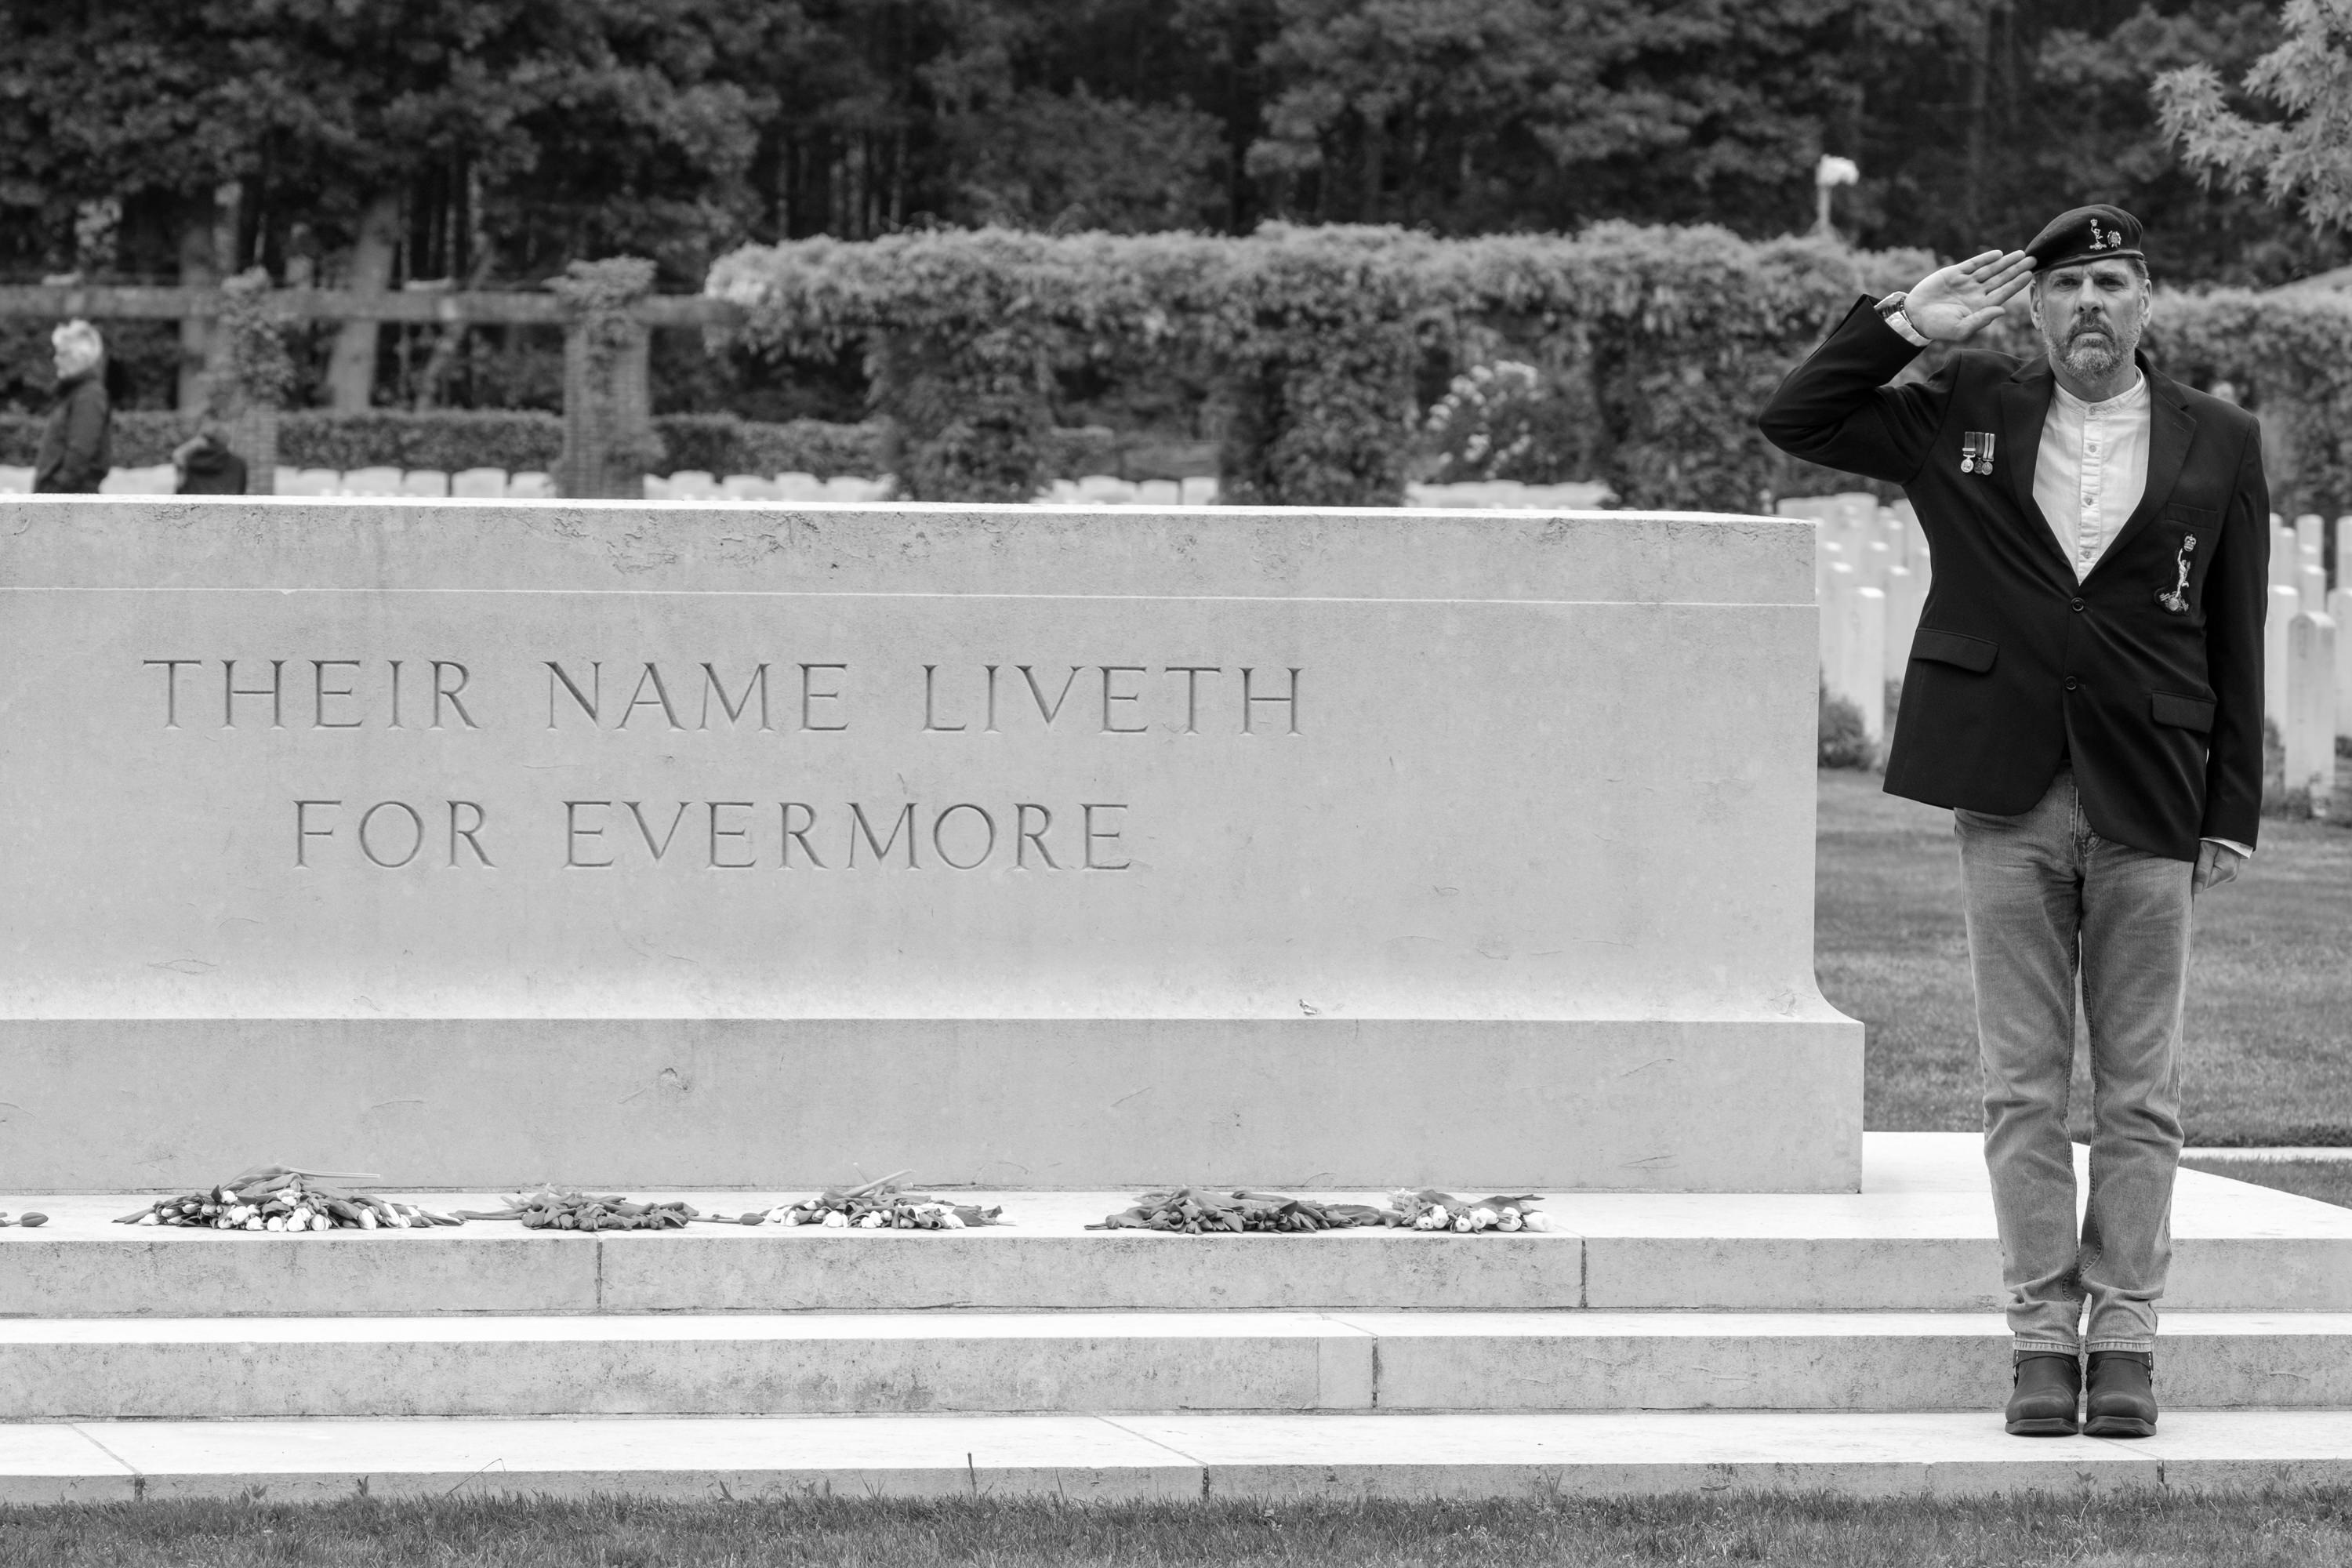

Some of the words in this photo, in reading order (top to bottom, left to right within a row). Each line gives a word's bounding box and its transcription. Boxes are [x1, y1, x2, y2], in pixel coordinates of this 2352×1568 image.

[143, 659, 481, 731] THEIR
[542, 661, 849, 732] NAME
[921, 663, 1304, 735] LIVETH
[292, 800, 499, 869] FOR
[561, 800, 1131, 871] EVERMORE
